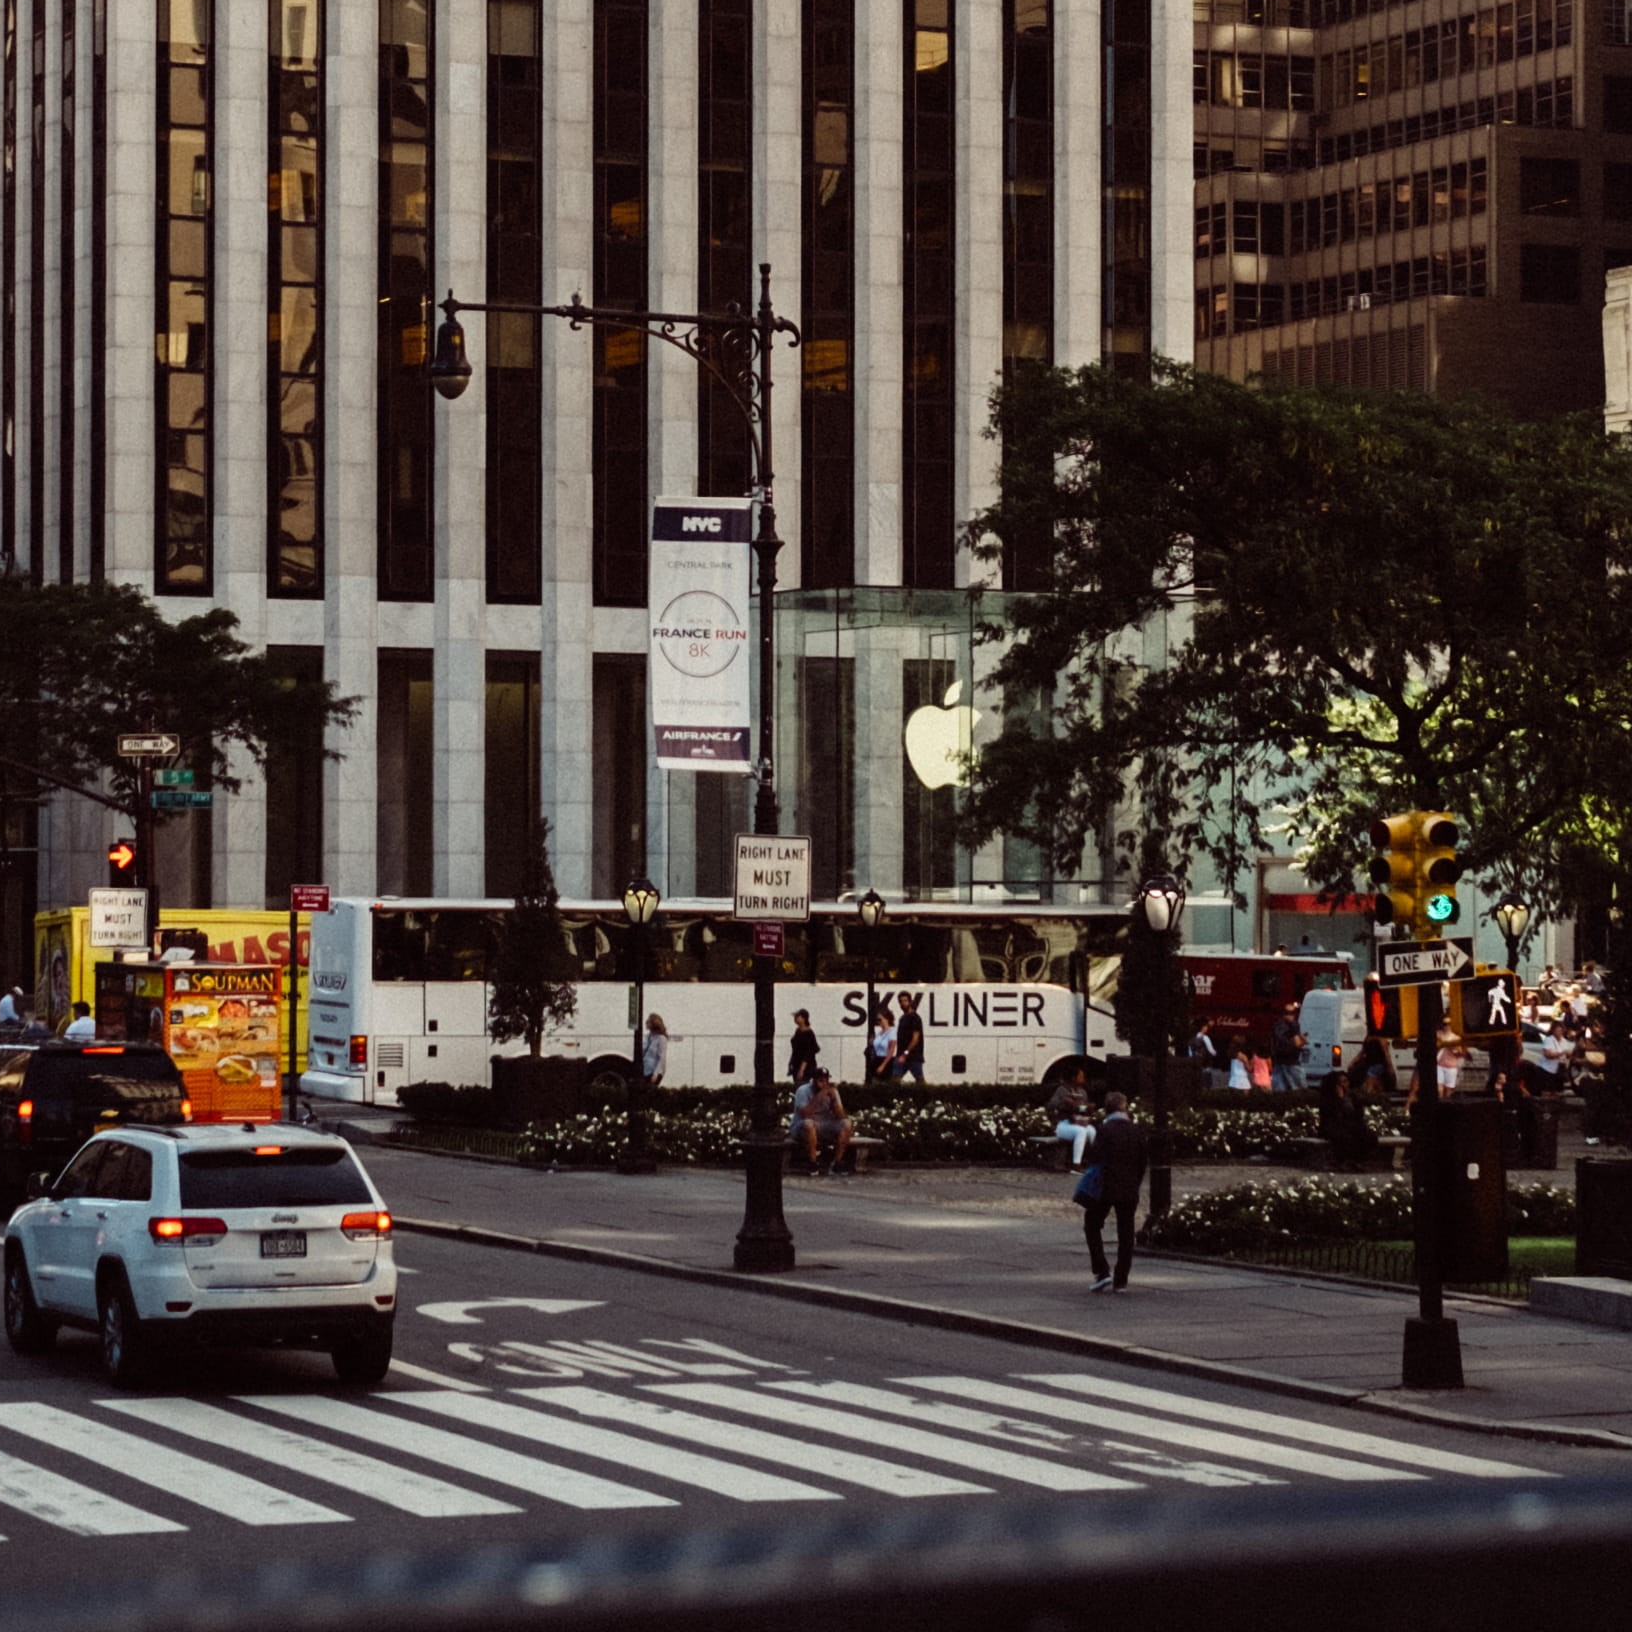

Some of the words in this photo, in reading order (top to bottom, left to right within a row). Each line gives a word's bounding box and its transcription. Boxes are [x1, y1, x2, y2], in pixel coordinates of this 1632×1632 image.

[682, 517, 722, 534] NYC
[668, 561, 707, 570] CENTRAL
[653, 628, 712, 639] FRANCE
[716, 630, 747, 640] RUN
[689, 642, 711, 658] 8K
[739, 846, 772, 859] RIGHT
[777, 848, 806, 861] LANE
[754, 870, 791, 886] MUST
[94, 897, 118, 907] RIGHT
[121, 898, 144, 907] LANE
[738, 895, 767, 909] TURN
[772, 896, 805, 910] RIGHT
[105, 914, 132, 924] MUST
[93, 930, 116, 940] TURN
[118, 930, 143, 940] RIGHT
[1392, 955, 1420, 972] ONE
[1432, 951, 1460, 969] WAY
[192, 972, 274, 992] SOUPMAN
[446, 1337, 814, 1378] ONLY
